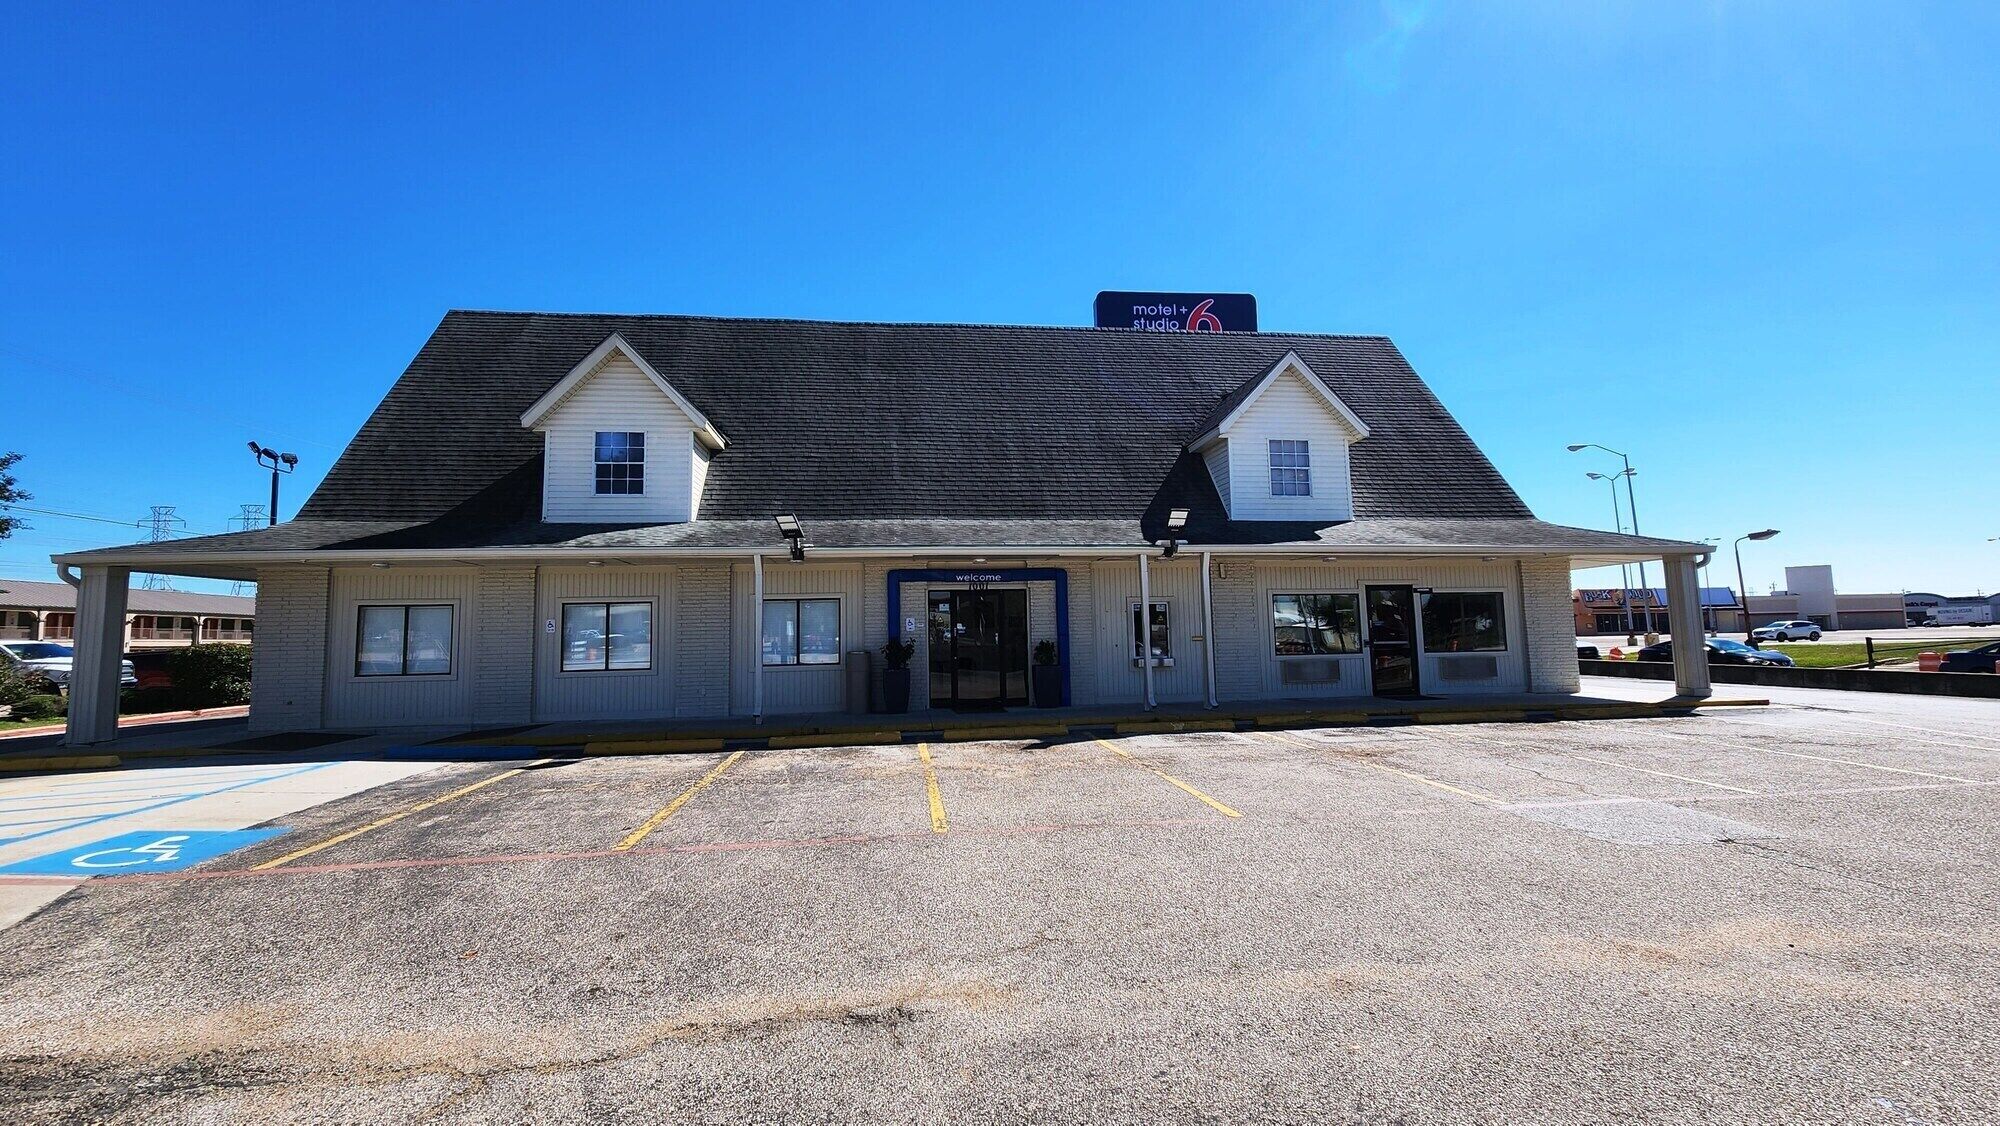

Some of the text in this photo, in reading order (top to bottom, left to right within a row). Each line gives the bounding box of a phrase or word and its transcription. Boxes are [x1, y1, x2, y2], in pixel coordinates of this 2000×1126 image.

[1133, 304, 1177, 315] motel
[1186, 298, 1223, 333] 6
[1133, 317, 1180, 331] studio
[956, 573, 1002, 582] welcome
